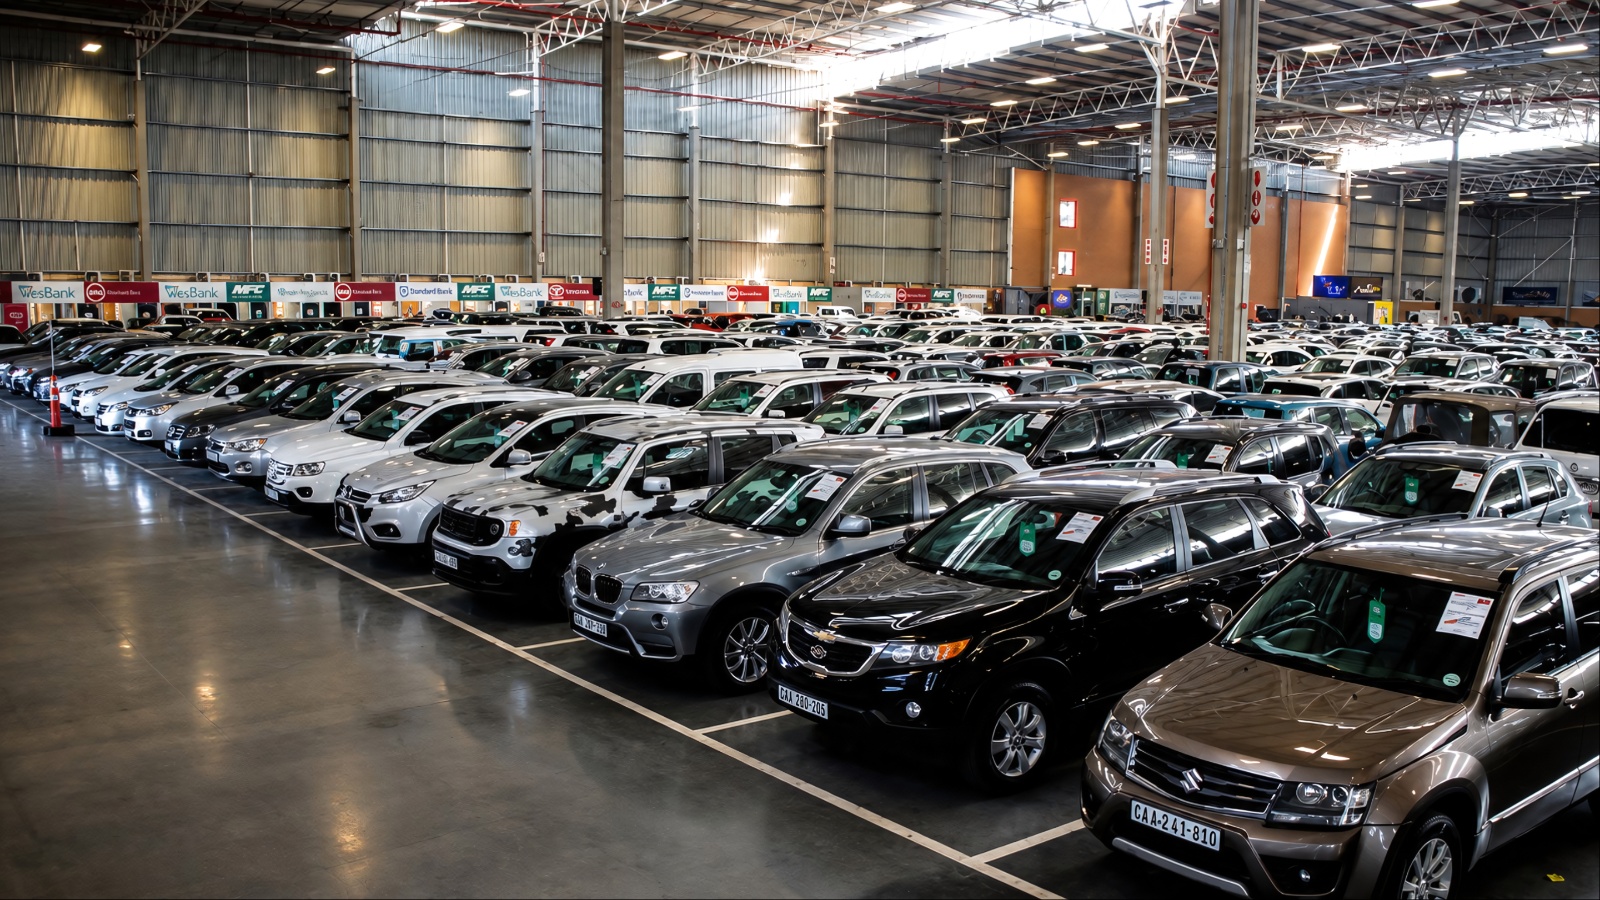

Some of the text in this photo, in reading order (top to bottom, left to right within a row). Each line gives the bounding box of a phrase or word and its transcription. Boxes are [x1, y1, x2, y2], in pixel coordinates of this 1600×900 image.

[18, 285, 75, 298] WesBank
[165, 285, 218, 298] WesBank
[232, 285, 265, 294] MFC
[461, 285, 491, 294] MFC
